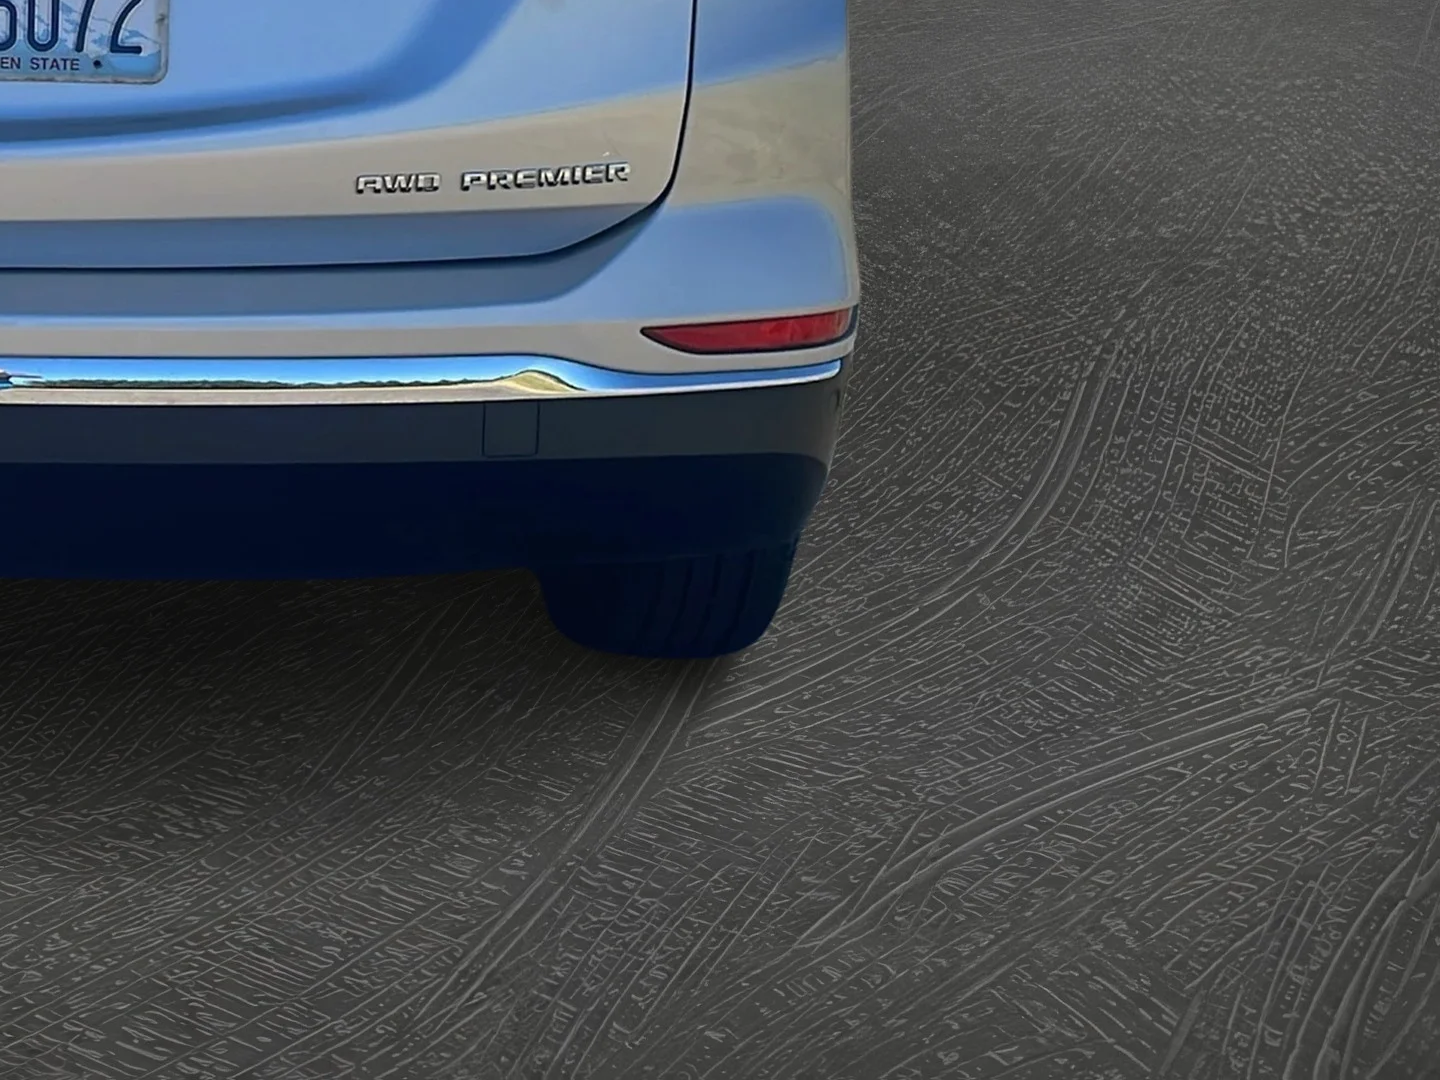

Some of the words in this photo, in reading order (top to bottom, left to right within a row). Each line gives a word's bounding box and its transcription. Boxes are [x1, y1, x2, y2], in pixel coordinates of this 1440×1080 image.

[29, 57, 80, 71] STATE
[356, 173, 441, 194] AWD
[460, 162, 632, 191] PREMIER
